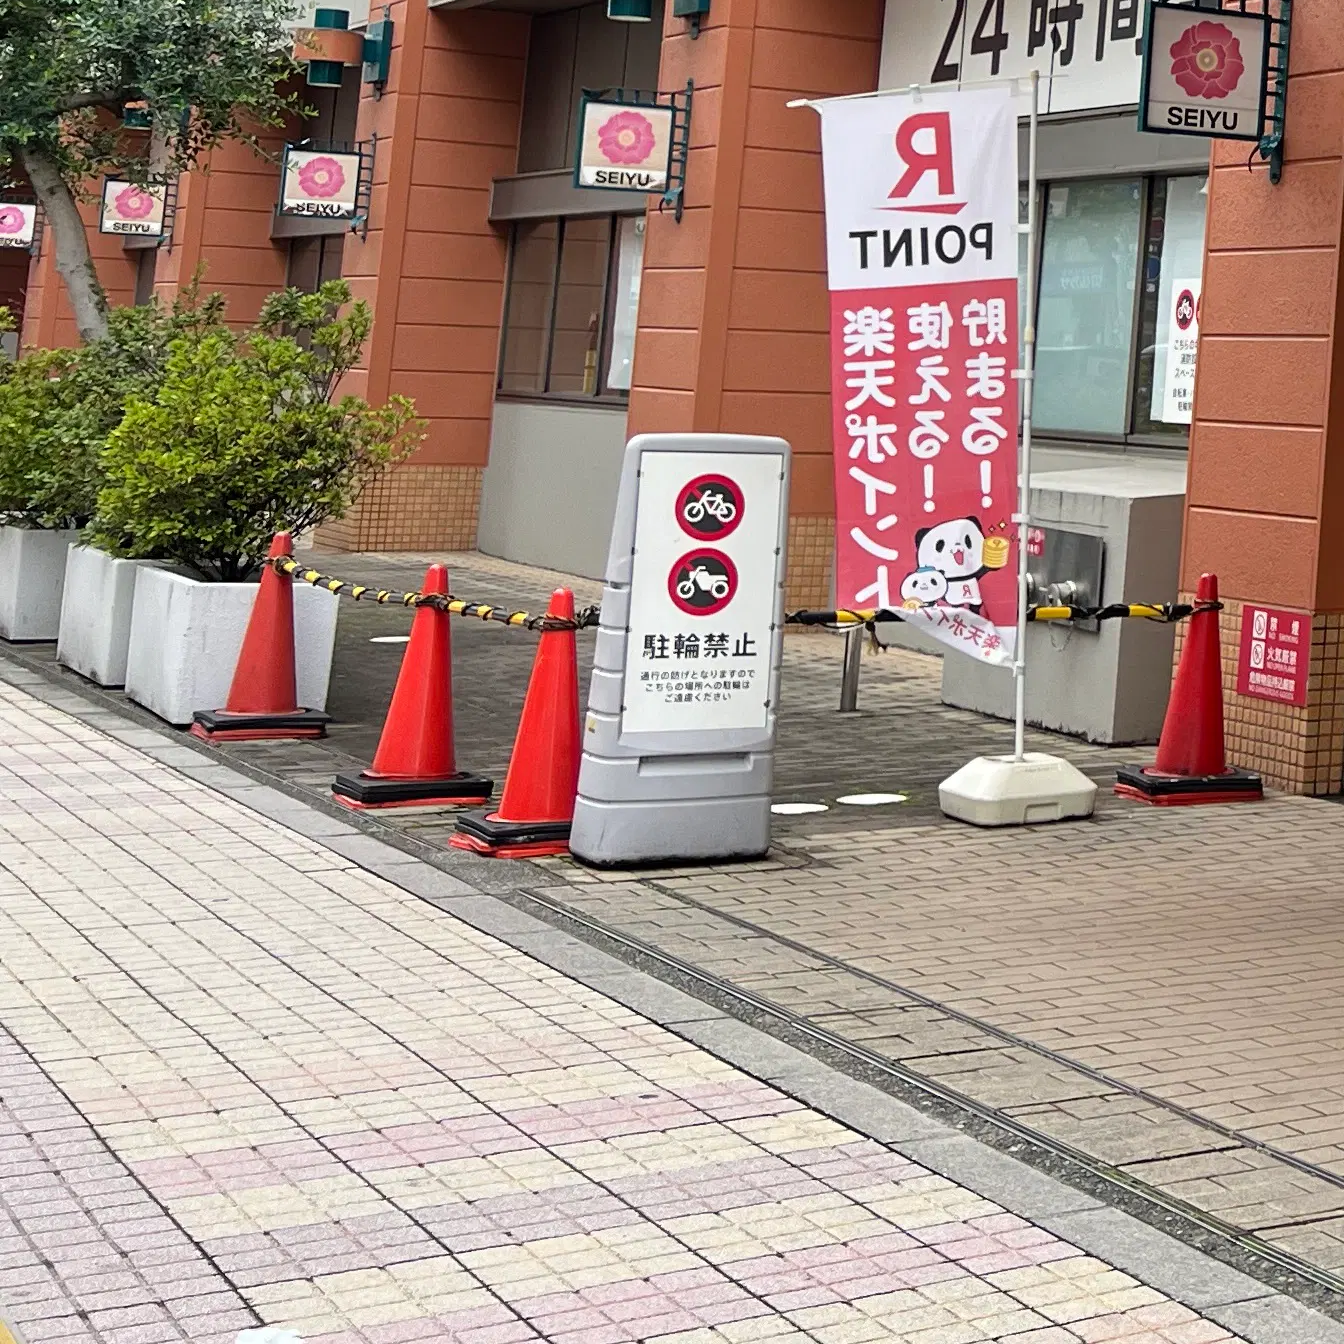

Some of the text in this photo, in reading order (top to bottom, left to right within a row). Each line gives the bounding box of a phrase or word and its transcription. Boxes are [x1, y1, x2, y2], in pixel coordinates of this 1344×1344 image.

[1167, 106, 1239, 131] SEIYU
[595, 170, 650, 186] SEIYU
[297, 202, 341, 214] SEIYU
[113, 222, 150, 233] SEIYU
[642, 632, 757, 660] 駐輪禁止
[640, 669, 756, 681] 通行の妨げとなりますので
[645, 681, 750, 692] こちらの場所への駐輪は
[664, 692, 732, 703] ご遠慮ください
